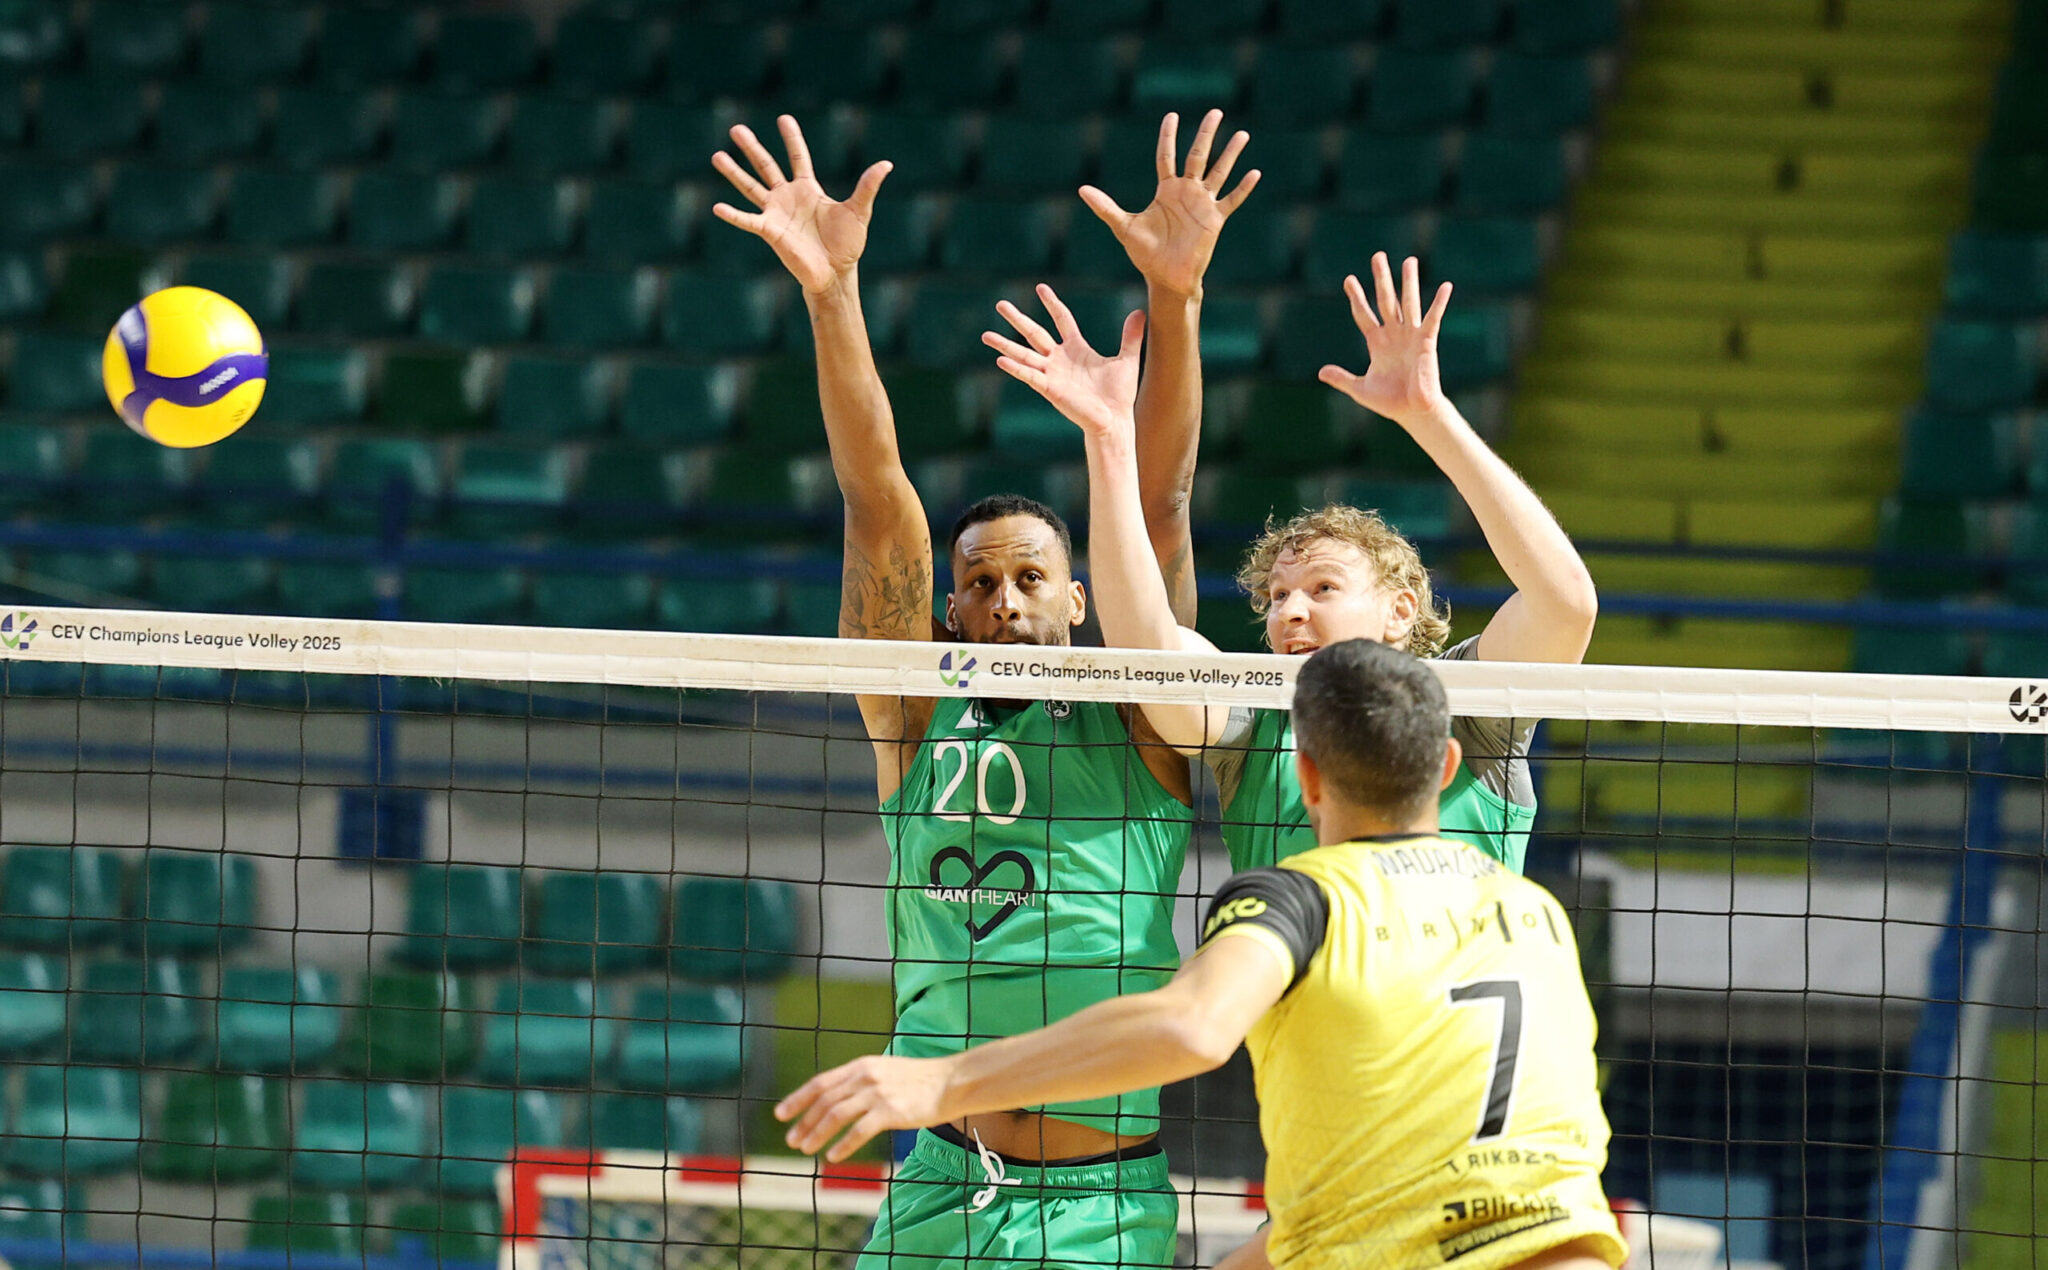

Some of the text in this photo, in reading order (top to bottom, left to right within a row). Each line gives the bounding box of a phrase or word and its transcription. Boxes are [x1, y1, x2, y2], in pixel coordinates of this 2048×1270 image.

[51, 624, 341, 652] CEV Champions League Volley 2025
[991, 661, 1284, 687] CEV Champions League Volley 2025
[932, 736, 1026, 825] 20
[1450, 980, 1523, 1140] 7
